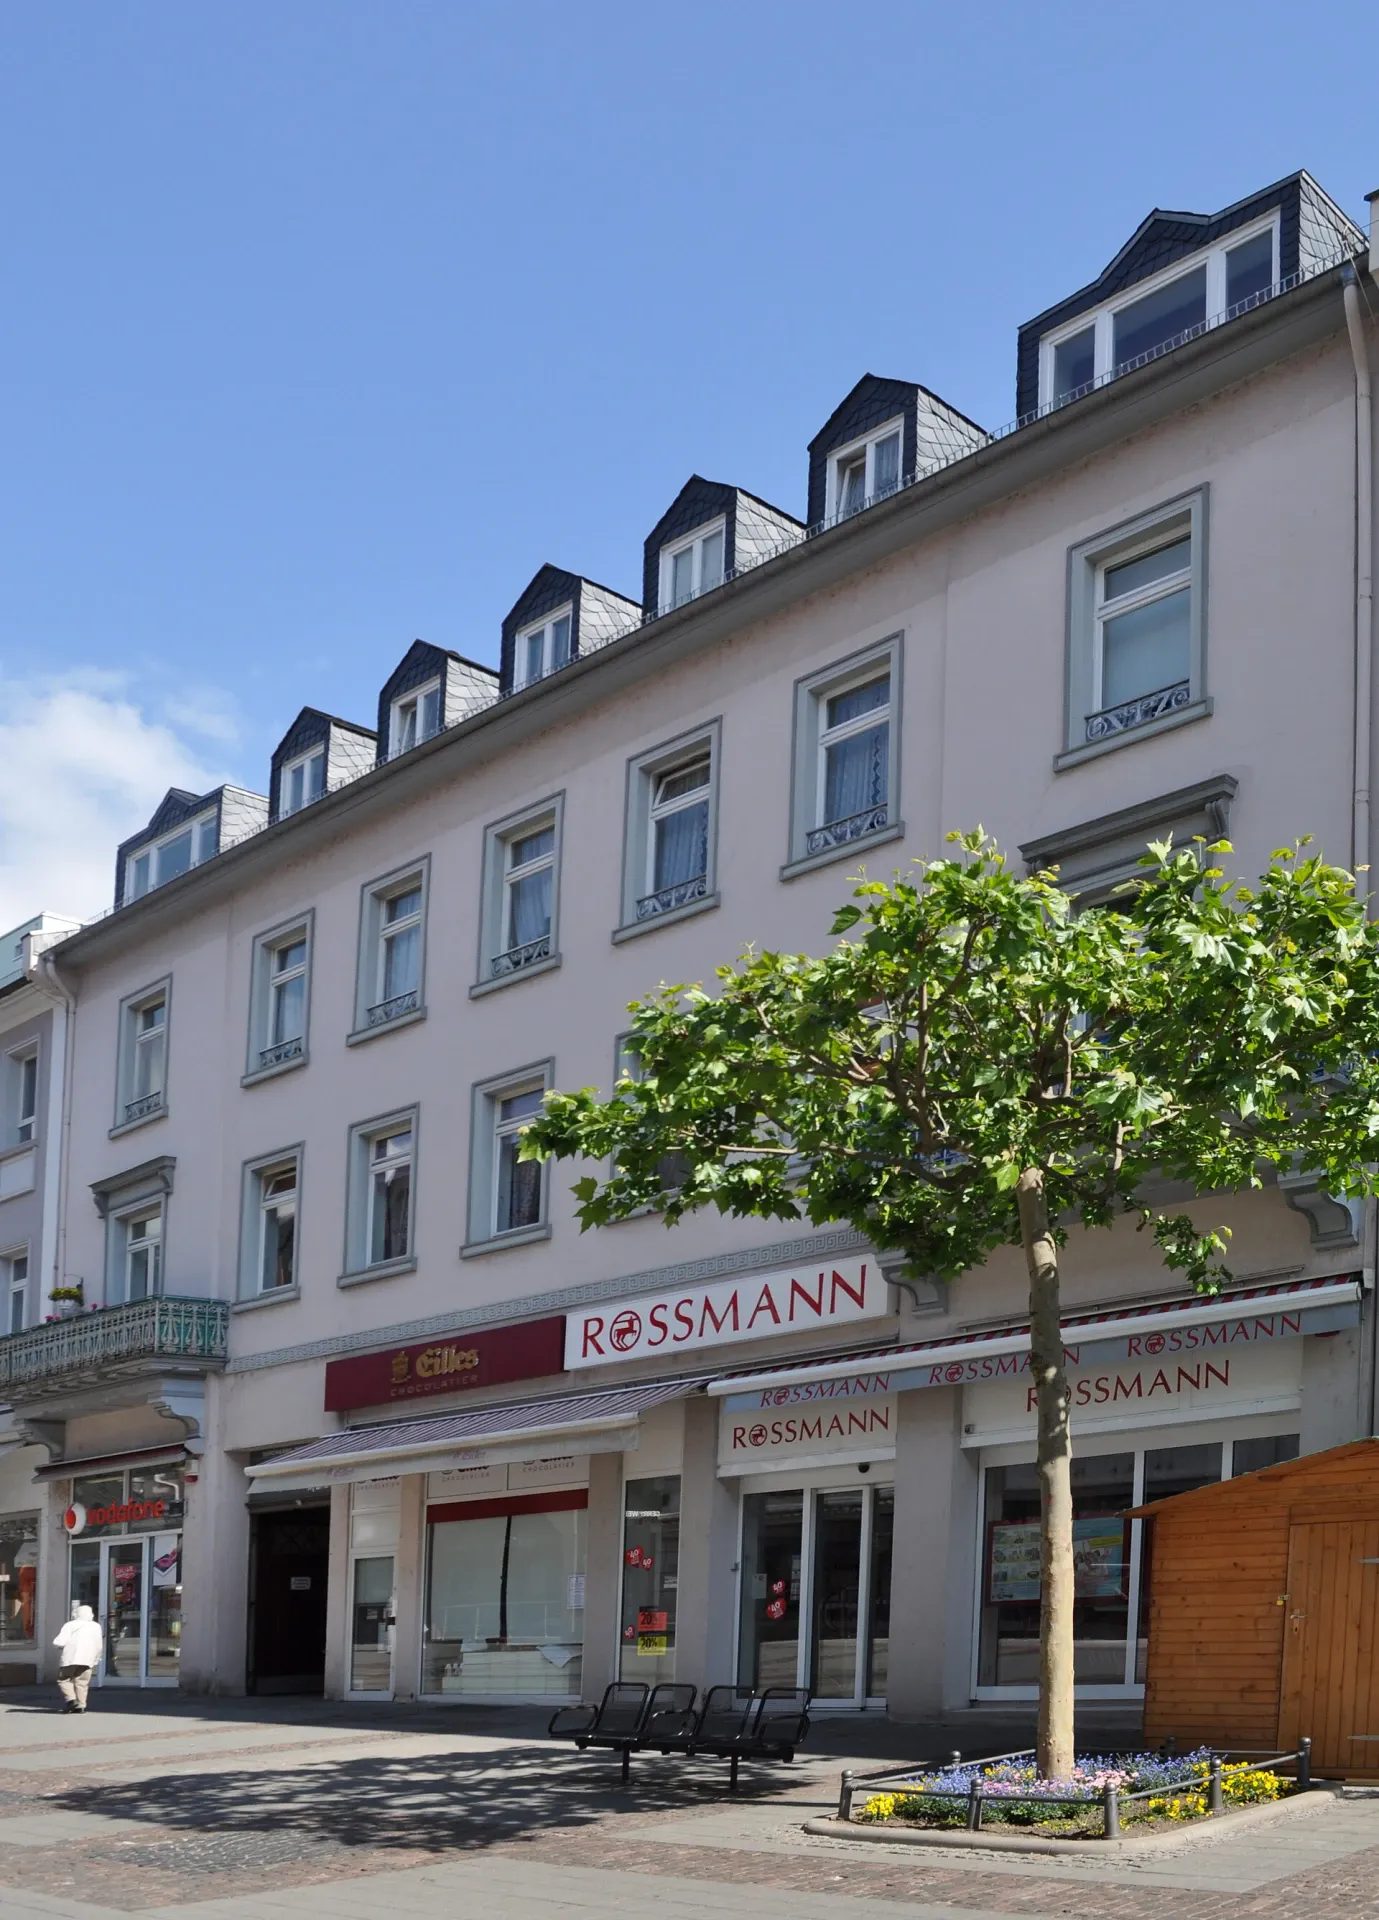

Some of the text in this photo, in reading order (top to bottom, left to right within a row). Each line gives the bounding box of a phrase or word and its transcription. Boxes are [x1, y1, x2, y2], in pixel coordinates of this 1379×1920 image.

[581, 1264, 867, 1358] ROSSMANN
[1127, 1312, 1301, 1357] ROSSMANN
[929, 1346, 1081, 1385] ROSSMAN
[390, 1374, 479, 1397] CHOCOLATIER
[760, 1373, 890, 1408] ROSSMANN
[732, 1406, 889, 1449] ROSSMANN
[87, 1497, 165, 1526] vodafone
